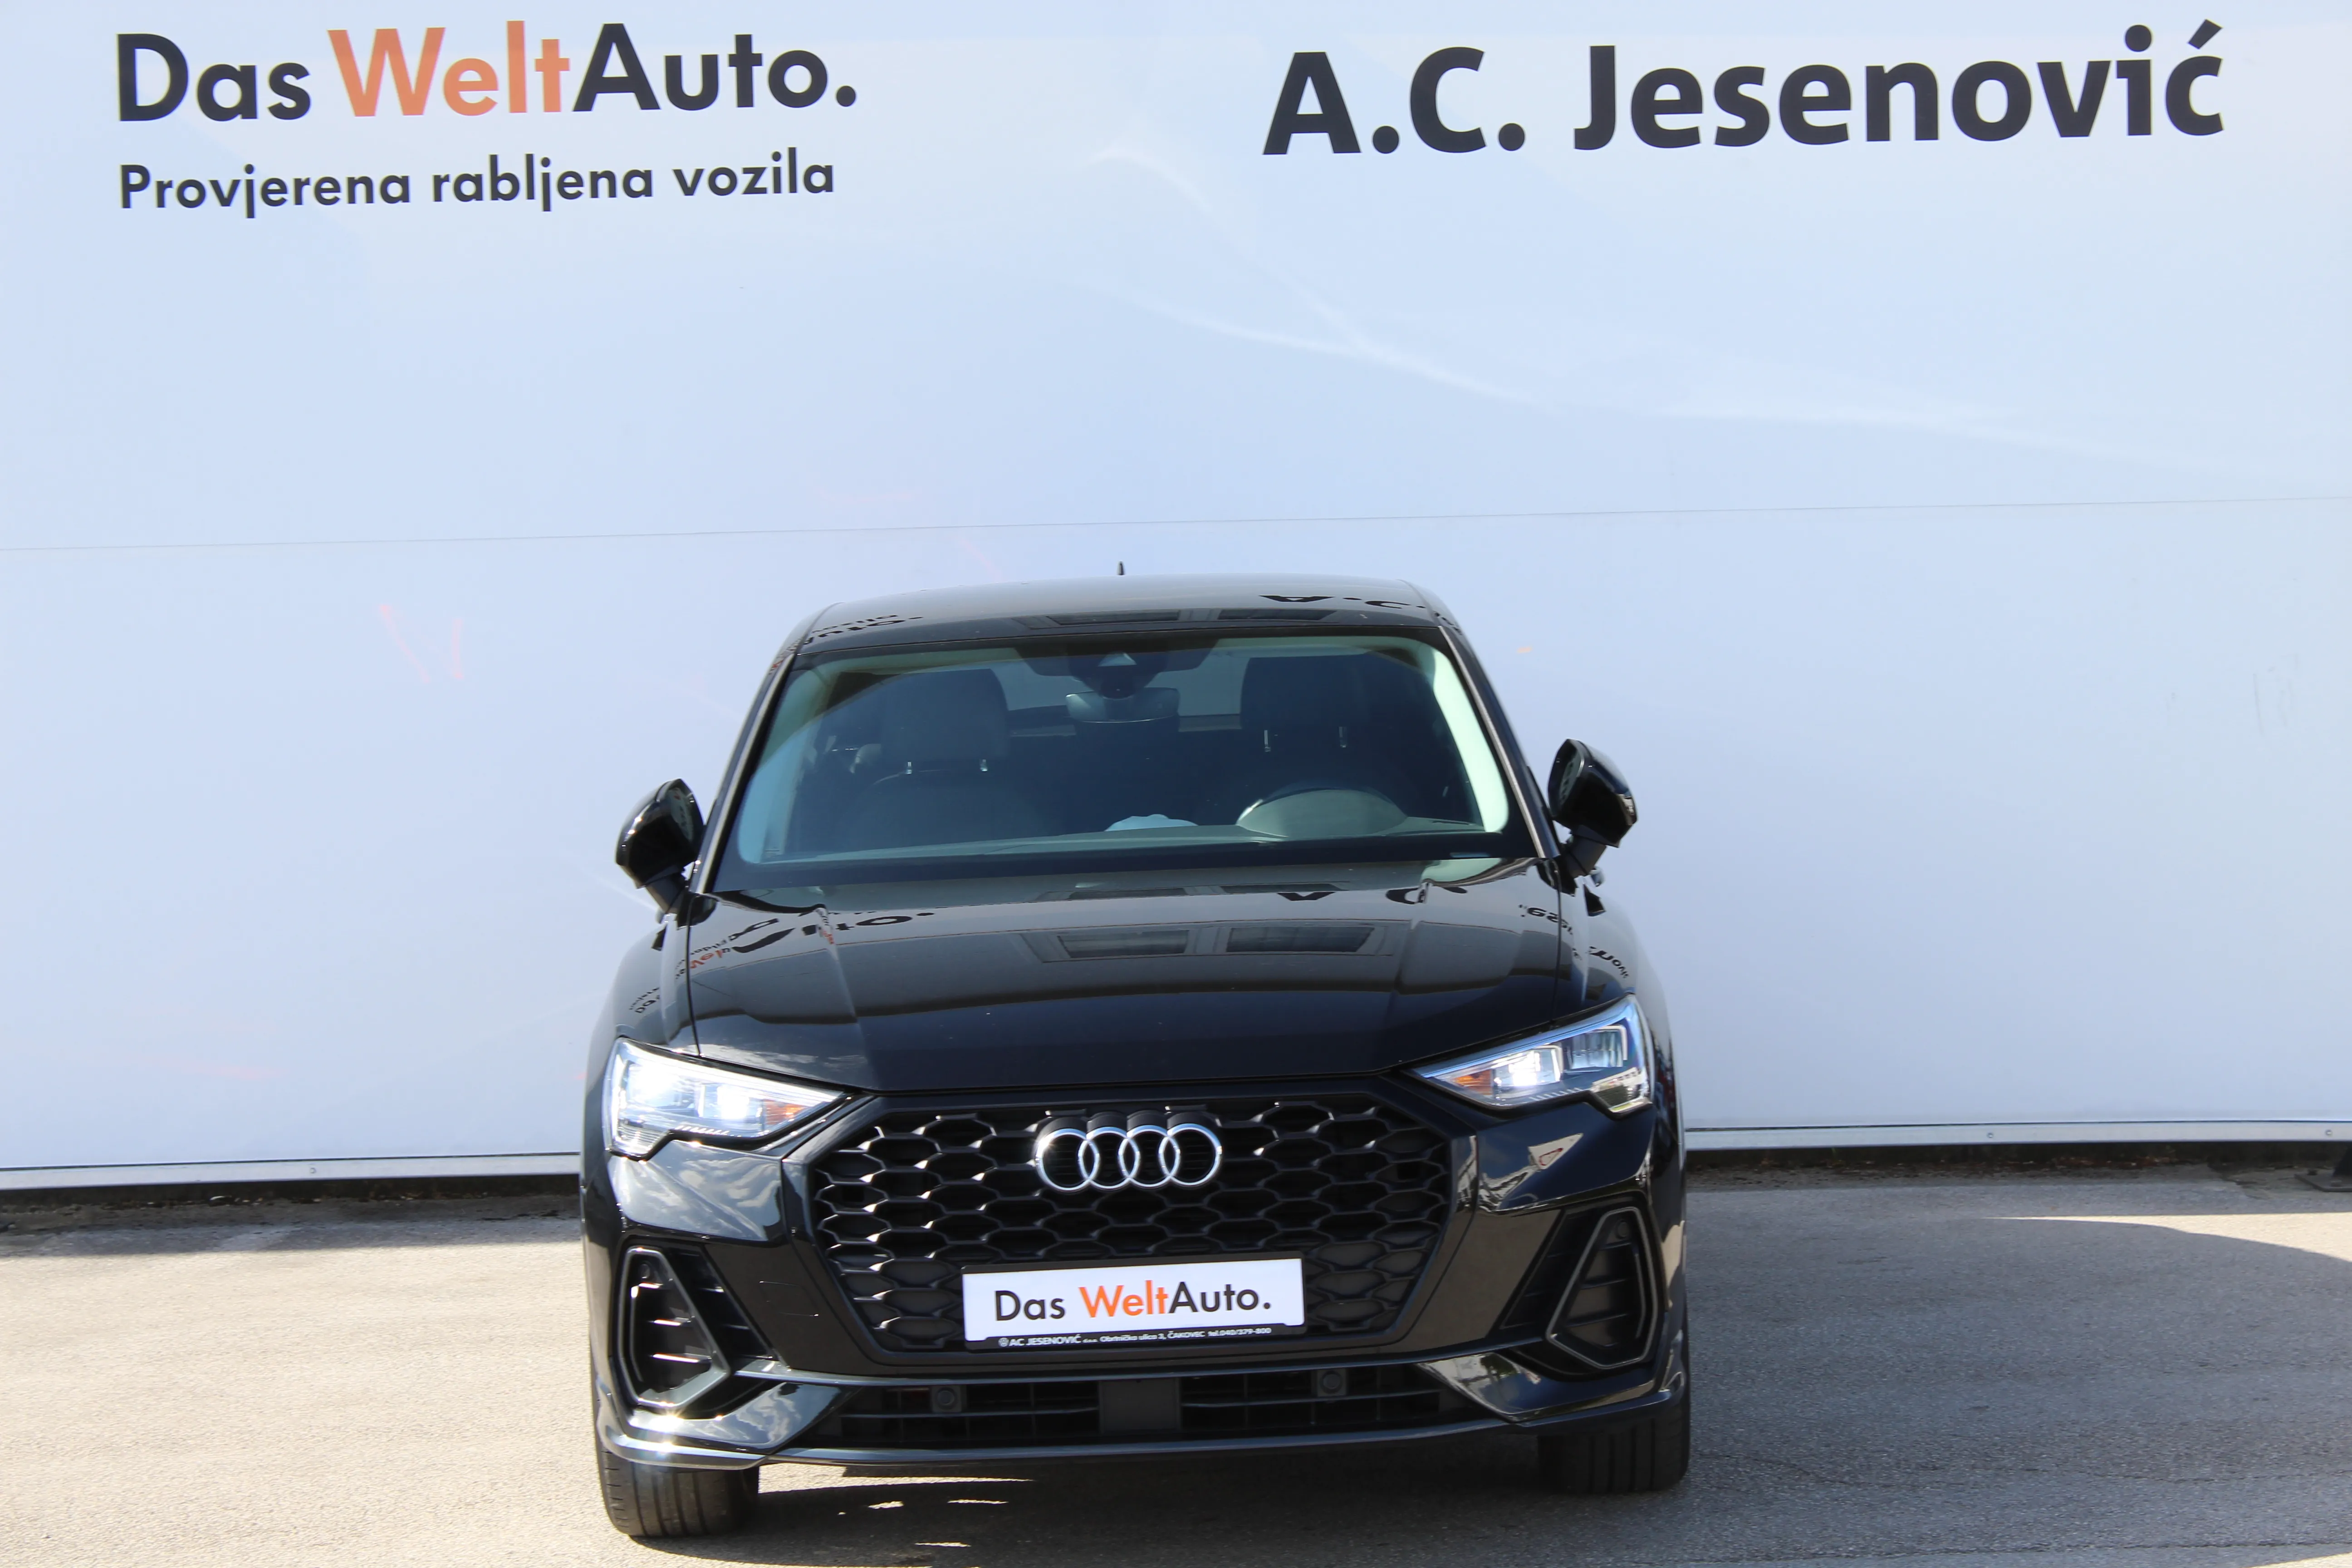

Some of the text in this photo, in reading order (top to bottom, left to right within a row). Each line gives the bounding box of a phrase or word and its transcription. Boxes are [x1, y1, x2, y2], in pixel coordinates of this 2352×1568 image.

[117, 20, 857, 122] Das WeltAuto.
[1262, 19, 2224, 156] A.C. Jesenović
[120, 147, 834, 219] Provjerena rabljena vozila
[995, 1280, 1271, 1321] Das WeltAuto.
[1008, 1338, 1024, 1347] AC
[1026, 1334, 1082, 1346] JESENOVIĆ
[1167, 1331, 1205, 1339] ČAKOVEC
